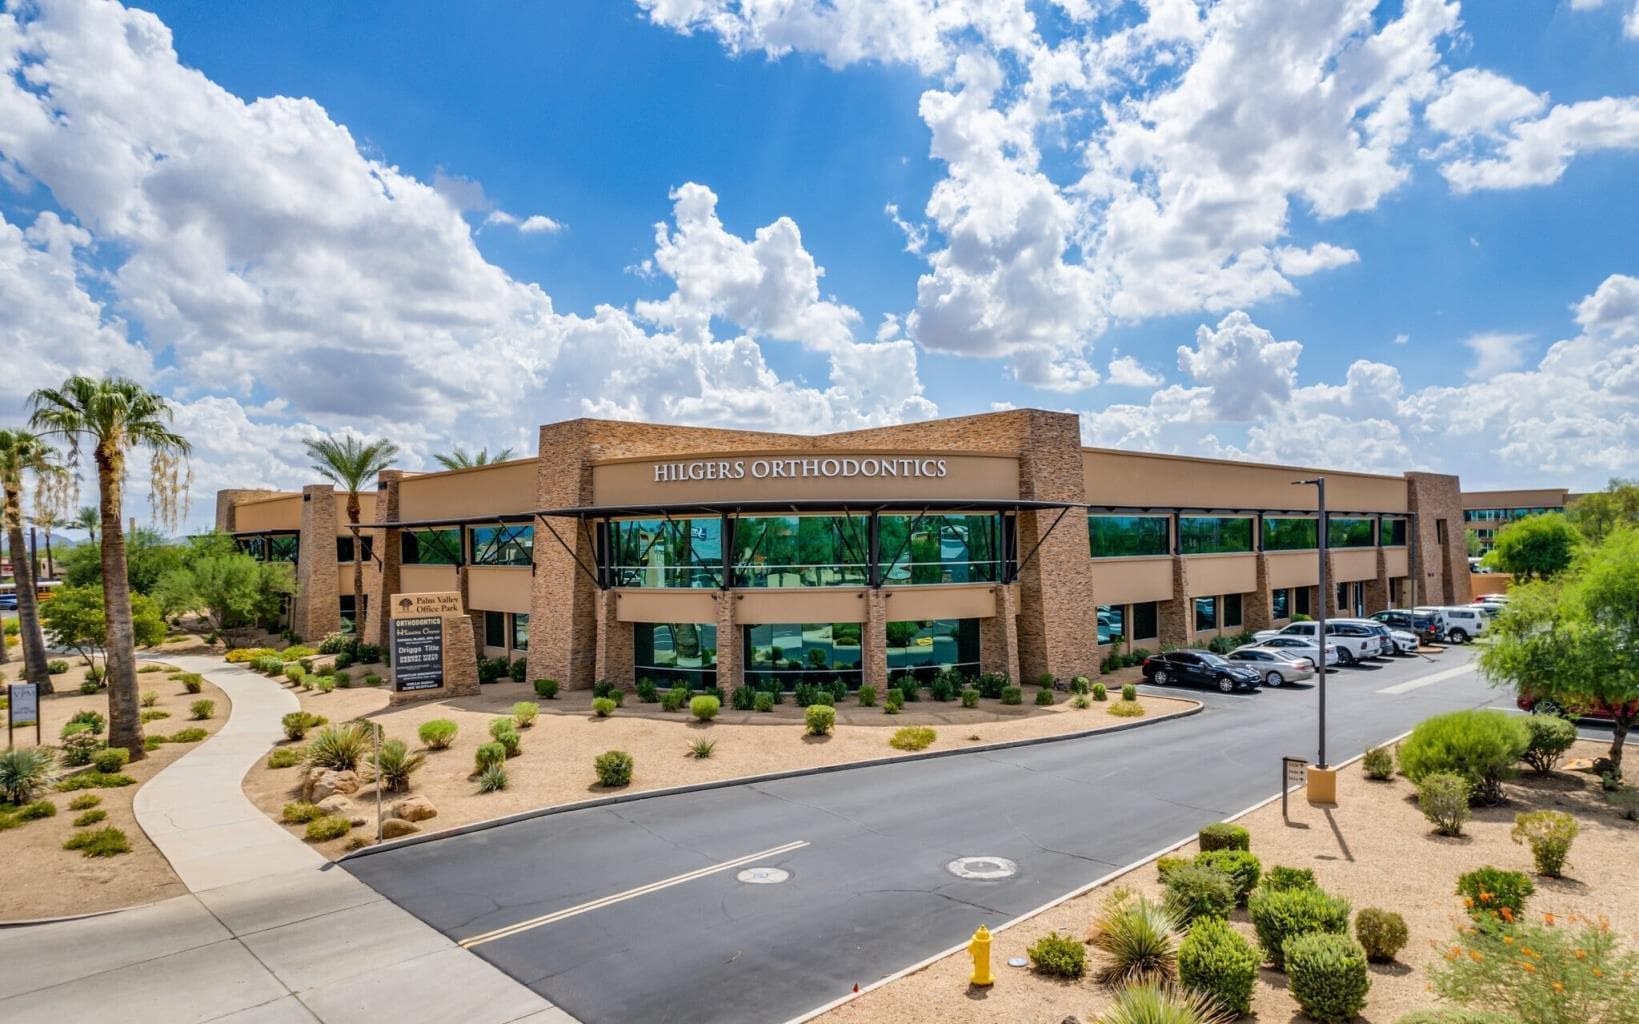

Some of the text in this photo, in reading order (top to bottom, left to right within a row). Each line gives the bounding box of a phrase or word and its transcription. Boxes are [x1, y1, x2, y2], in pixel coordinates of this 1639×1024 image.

[653, 459, 947, 482] HILGERS ORTHODONTICS
[437, 596, 458, 604] Valley
[416, 604, 458, 613] Office Park
[396, 618, 440, 626] ORTHODONTICS
[398, 646, 422, 654] Driggs
